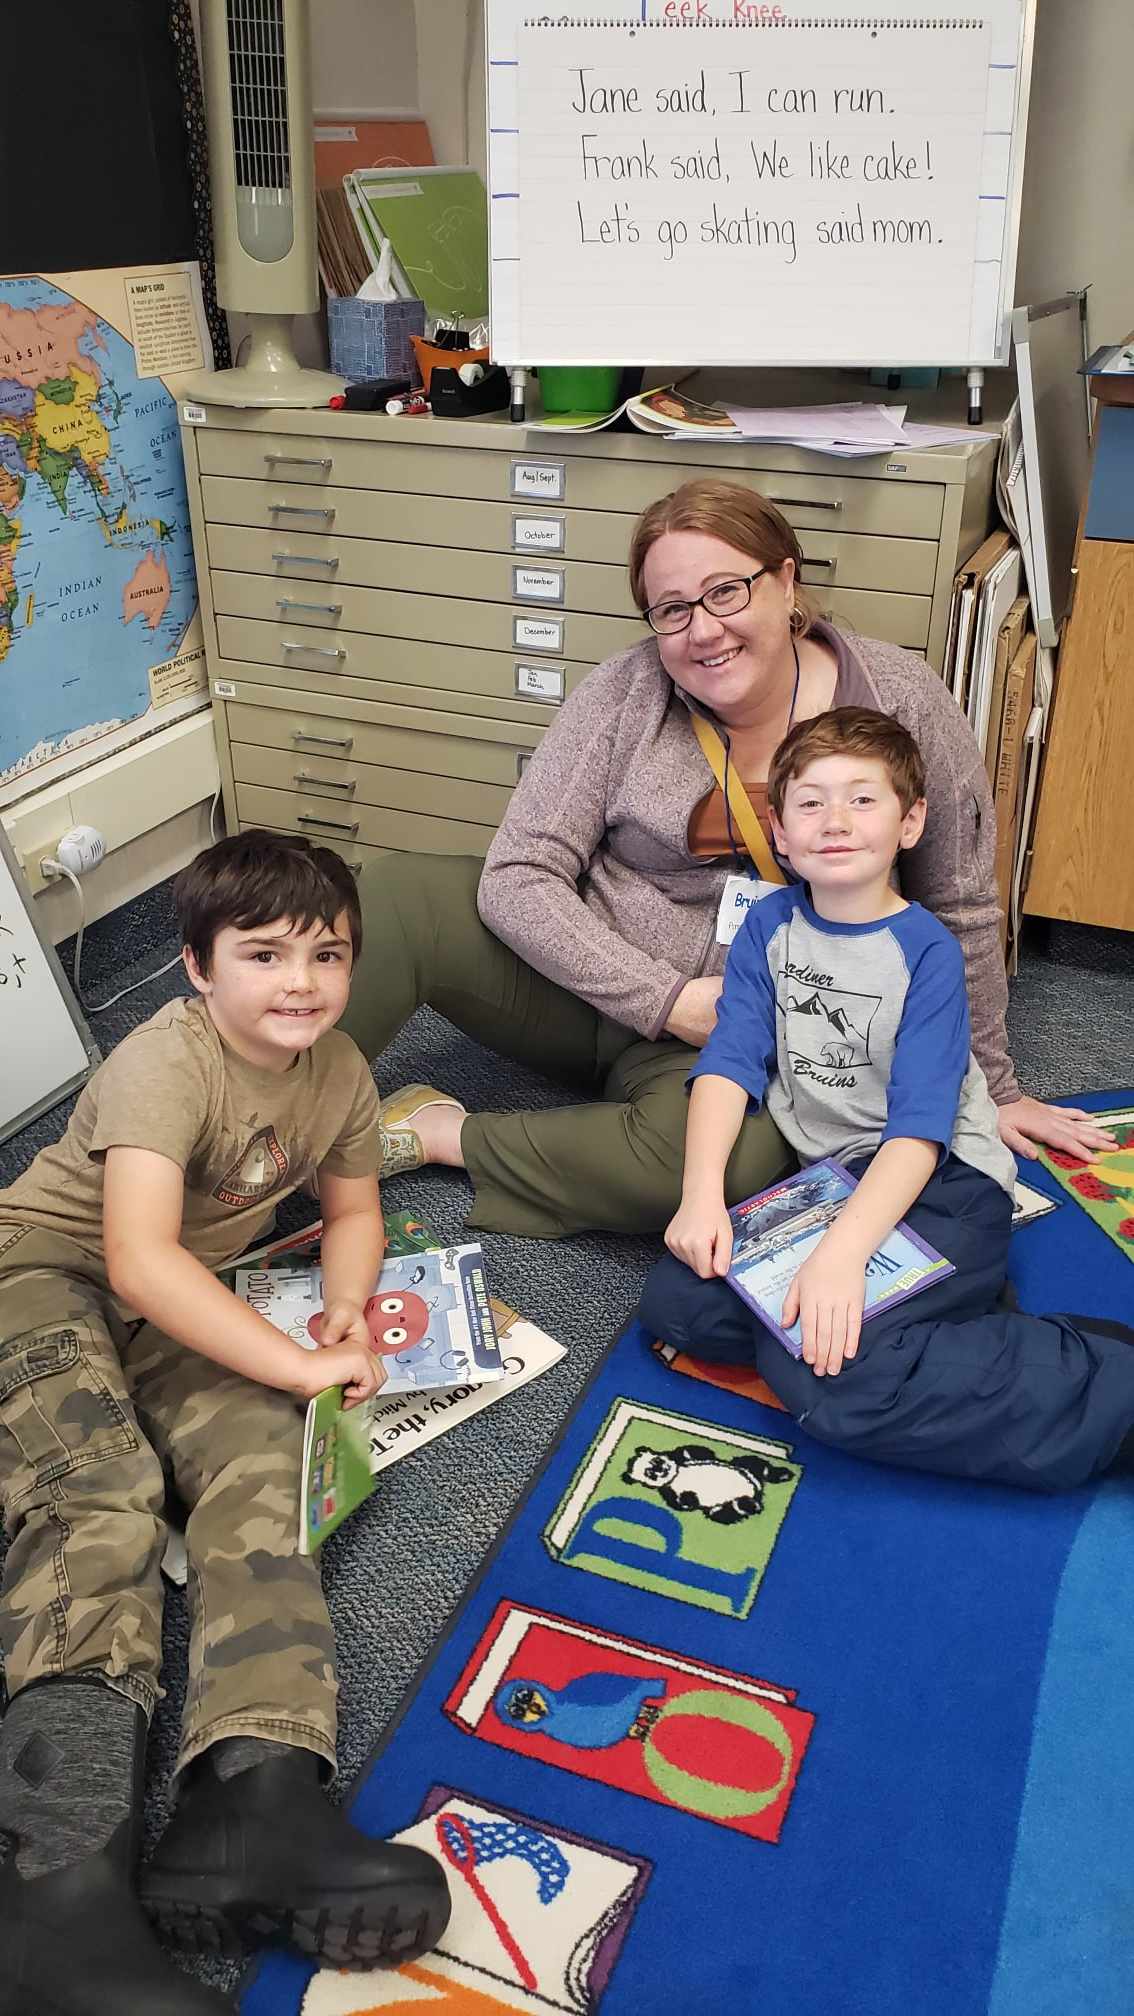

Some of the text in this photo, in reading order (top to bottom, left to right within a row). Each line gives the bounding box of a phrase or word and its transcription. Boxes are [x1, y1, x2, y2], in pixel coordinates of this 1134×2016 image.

[568, 68, 895, 116] Jane said, I can run.
[581, 135, 936, 183] Frank said, We like cake!
[578, 201, 943, 263] Let's go skating said mom.
[134, 397, 167, 417] PACIFIC
[52, 419, 83, 434] CHINA
[150, 431, 177, 447] OCEAN
[109, 520, 150, 536] INDONESIA
[524, 531, 556, 540] October
[59, 576, 102, 597] INDIAN
[523, 576, 554, 586] November
[130, 586, 164, 600] AUSTRALIA
[61, 603, 99, 622] OCEAN
[524, 627, 556, 637] December
[152, 653, 201, 677] WORLD POLITICAL
[999, 752, 1012, 796] WHITE
[793, 1059, 858, 1088] Bruins
[472, 1268, 484, 1292] OSWALD
[899, 1269, 922, 1288] TRUE
[476, 1292, 488, 1307] PETE
[383, 1414, 427, 1441] the
[561, 1496, 757, 1615] P
[642, 1689, 794, 1820] O
